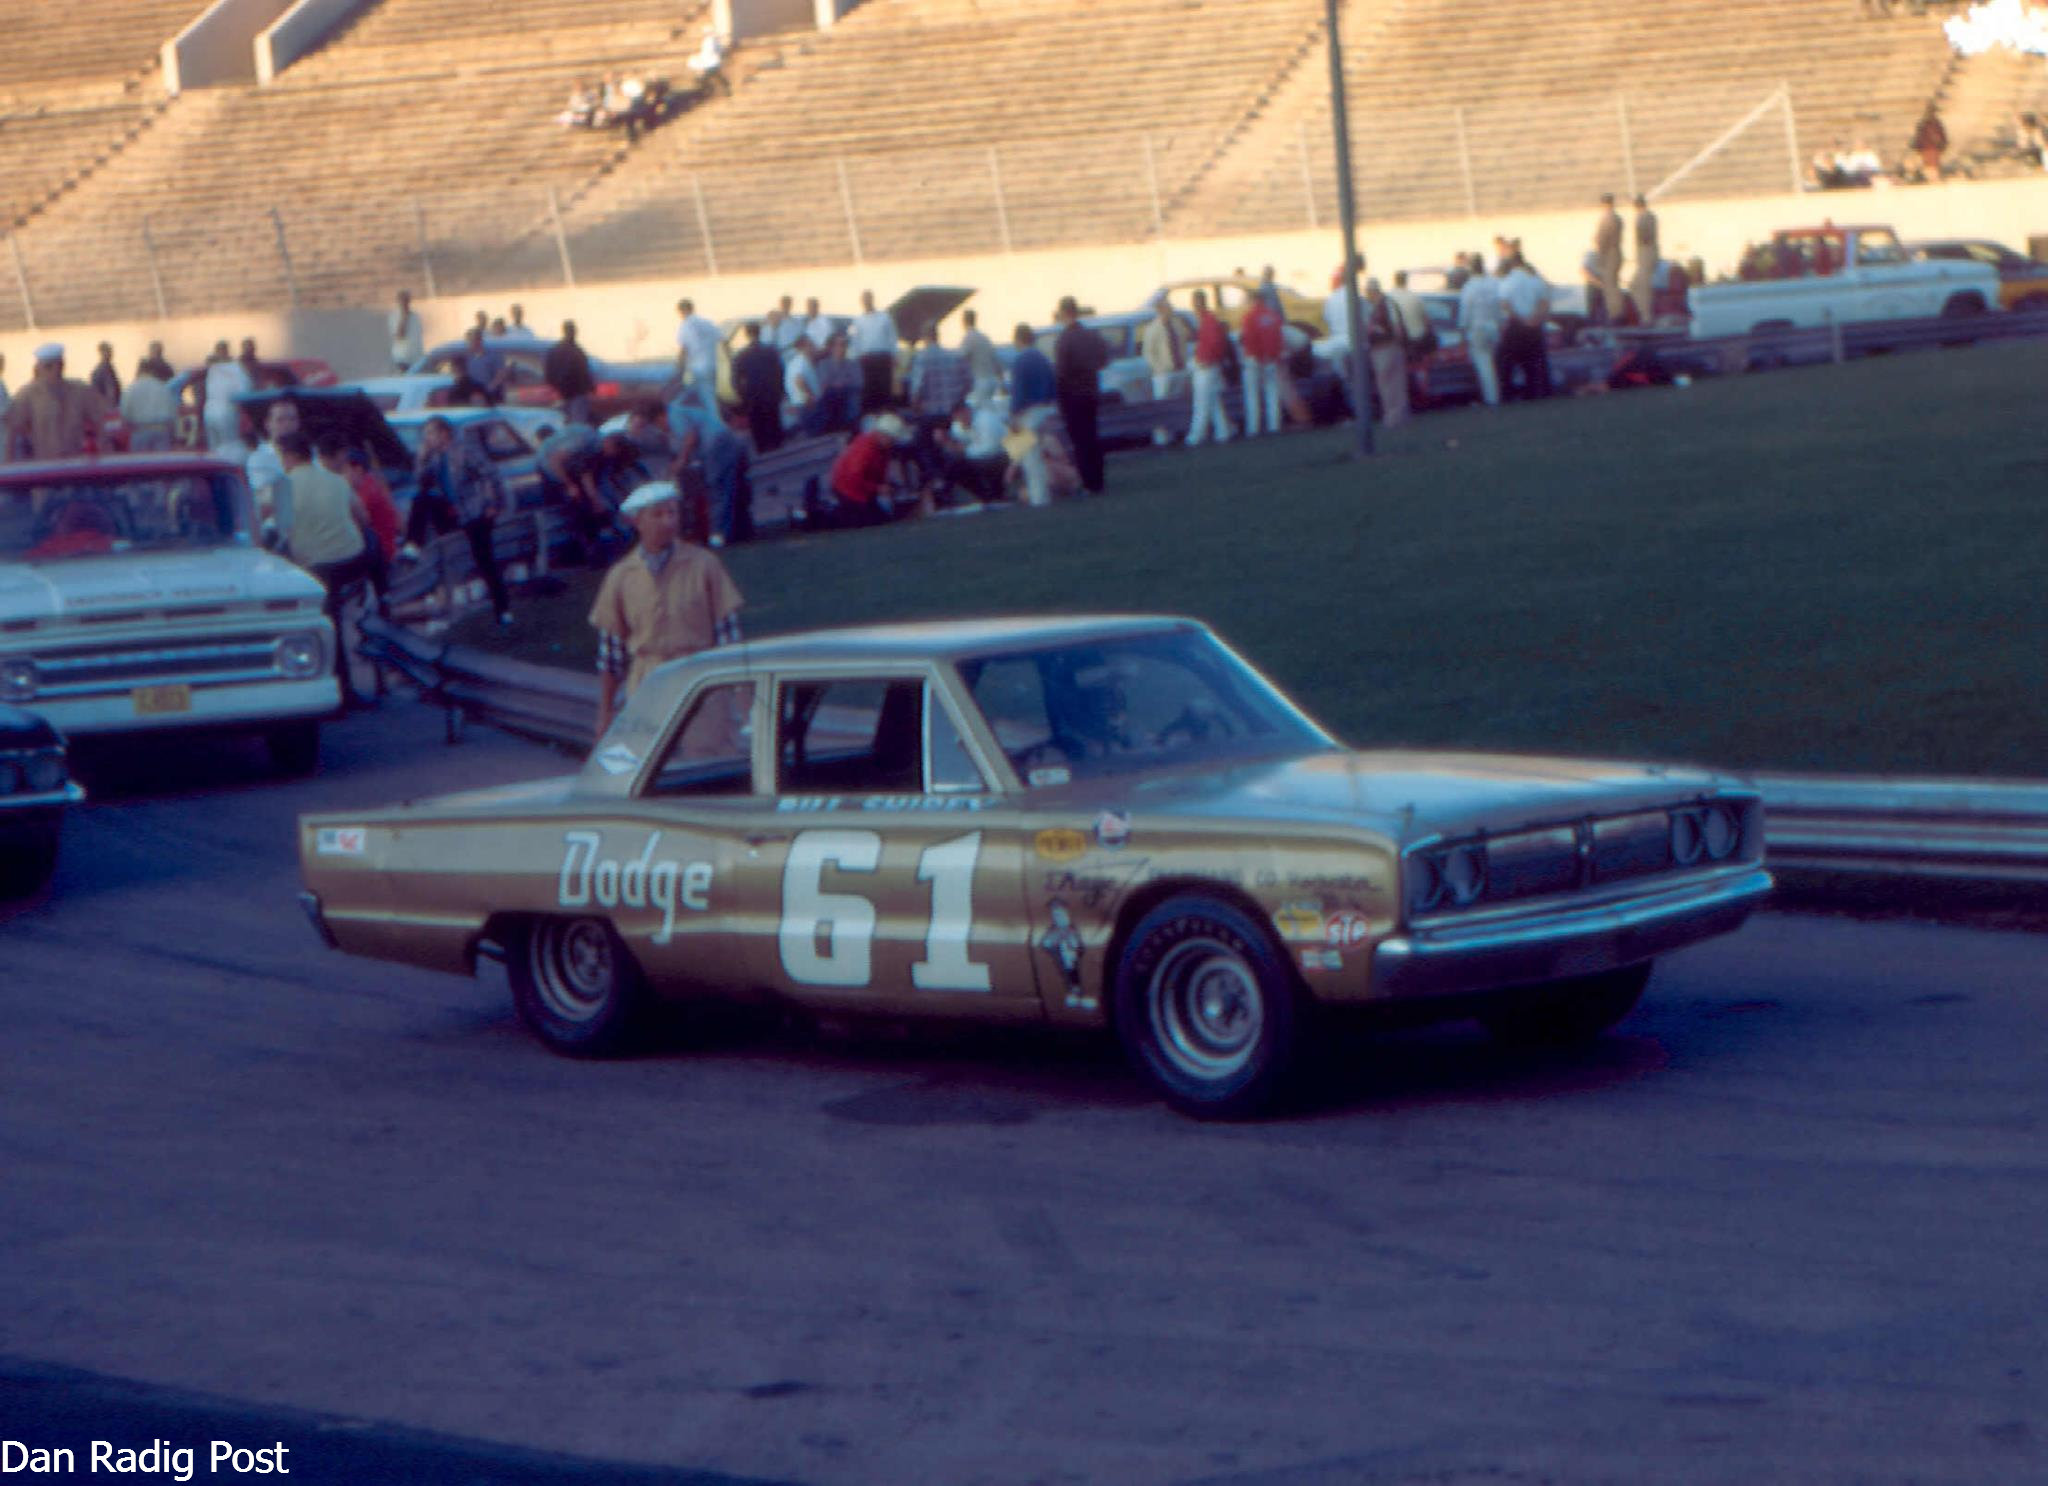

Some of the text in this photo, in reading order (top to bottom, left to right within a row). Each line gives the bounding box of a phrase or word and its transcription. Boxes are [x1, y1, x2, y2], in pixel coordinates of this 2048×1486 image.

[558, 831, 714, 945] Dodge
[779, 830, 992, 993] 61
[1327, 912, 1368, 946] STP
